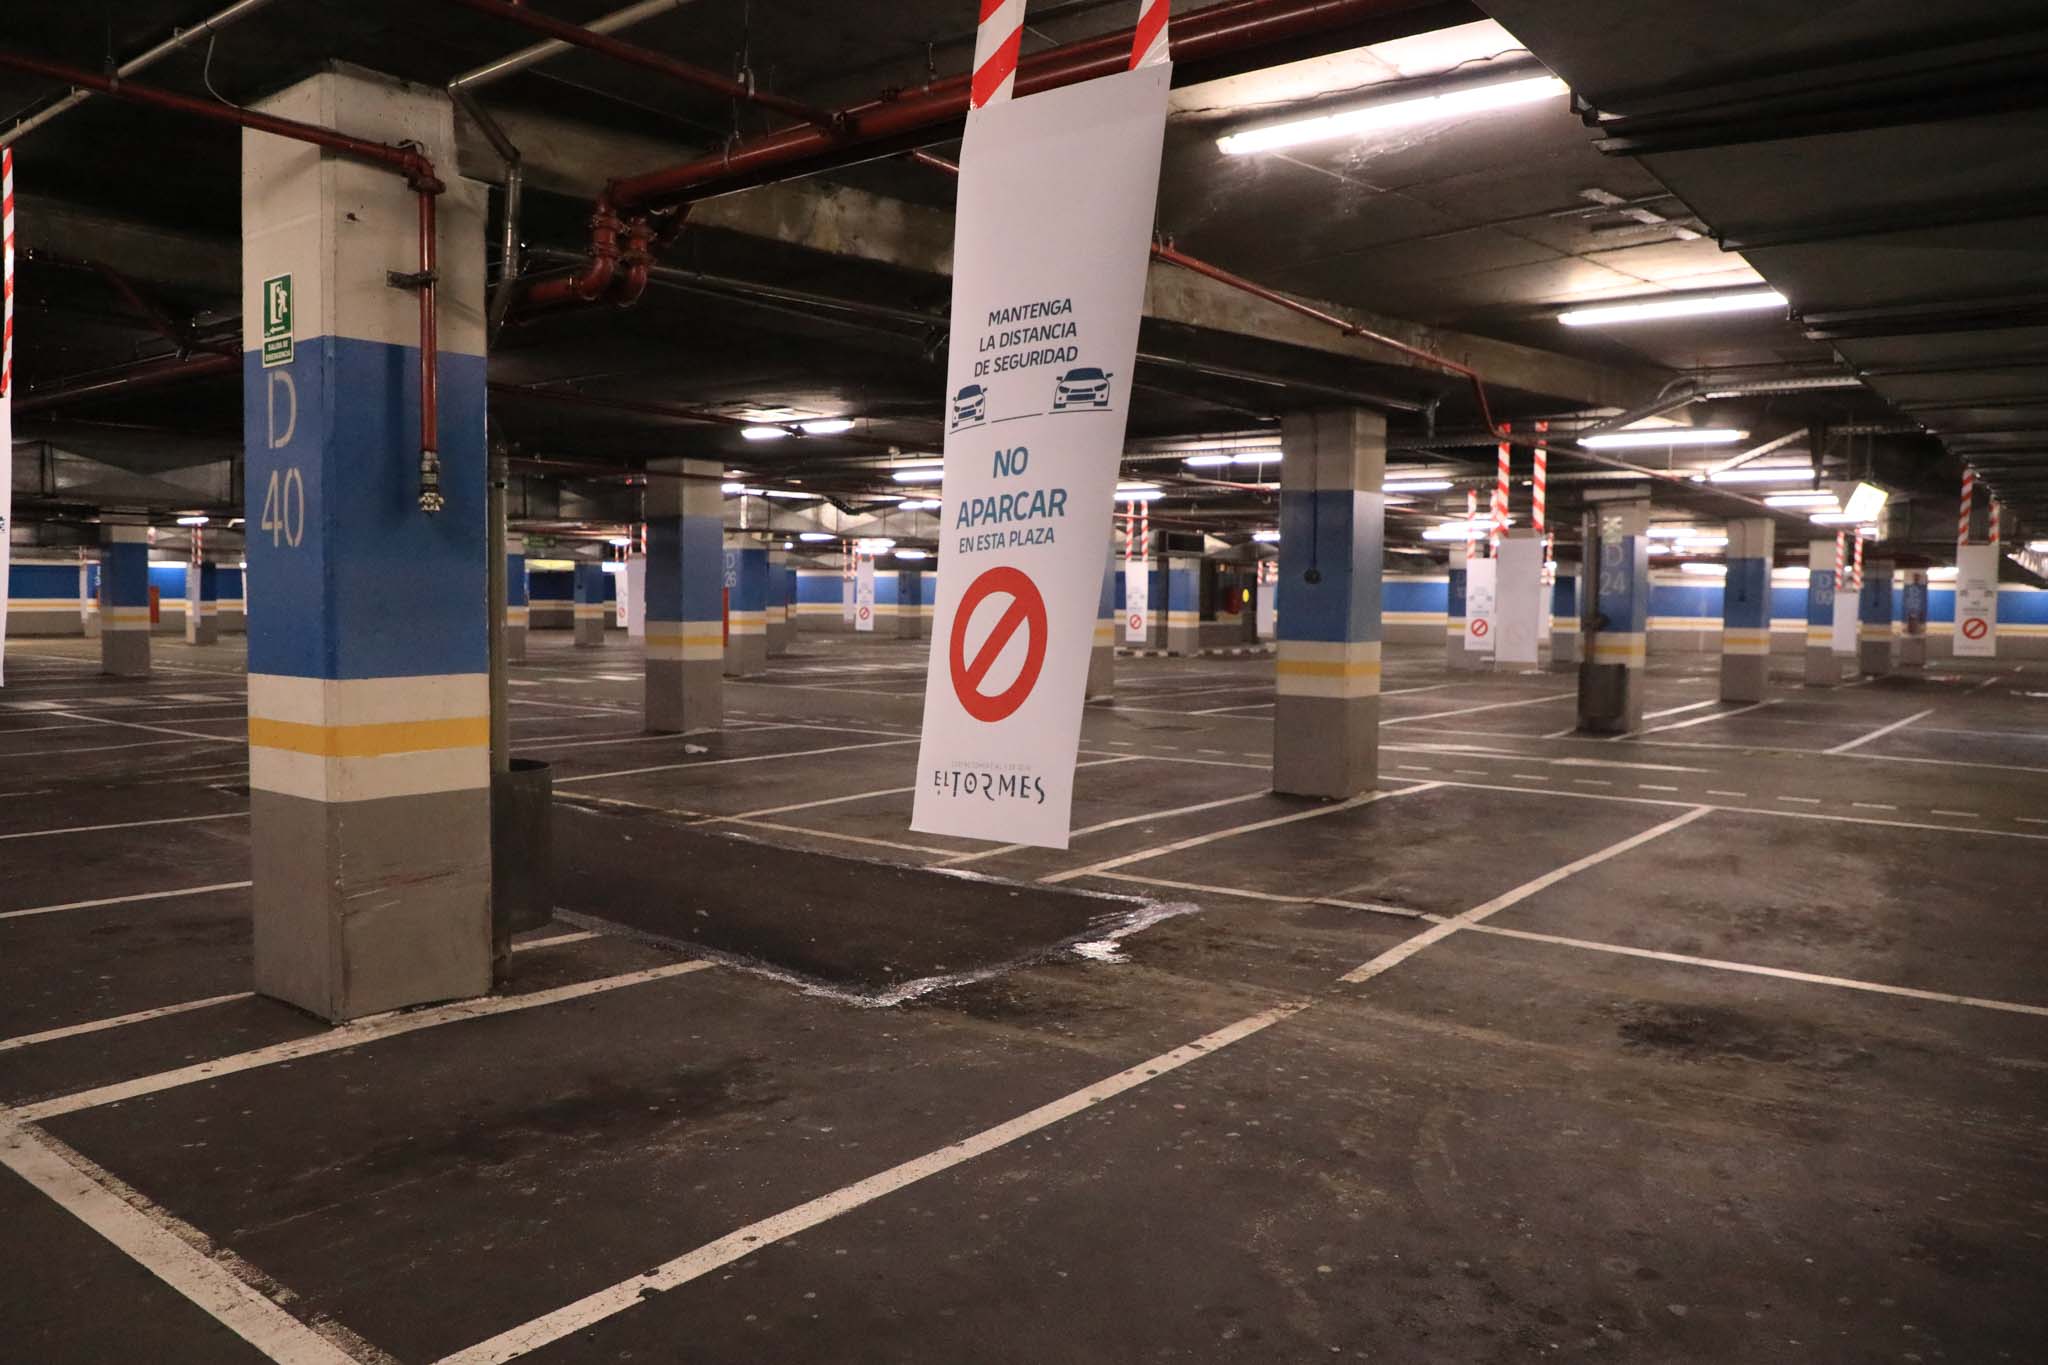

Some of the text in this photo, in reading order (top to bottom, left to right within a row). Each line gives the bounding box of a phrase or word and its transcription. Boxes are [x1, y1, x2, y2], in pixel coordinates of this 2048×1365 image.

[988, 298, 1072, 327] MANTENGA
[979, 322, 1077, 353] LA DISTANCIA
[974, 346, 1078, 377] DE SEGURIDAD
[268, 370, 297, 449] D
[993, 446, 1028, 478] NO
[261, 467, 305, 548] 40
[957, 488, 1067, 529] APARCAR
[959, 527, 1055, 553] EN ESTA PLAZA
[1606, 544, 1623, 567] D
[726, 553, 735, 569] D
[1599, 571, 1625, 596] 24
[934, 771, 1046, 805] EL TORMES
